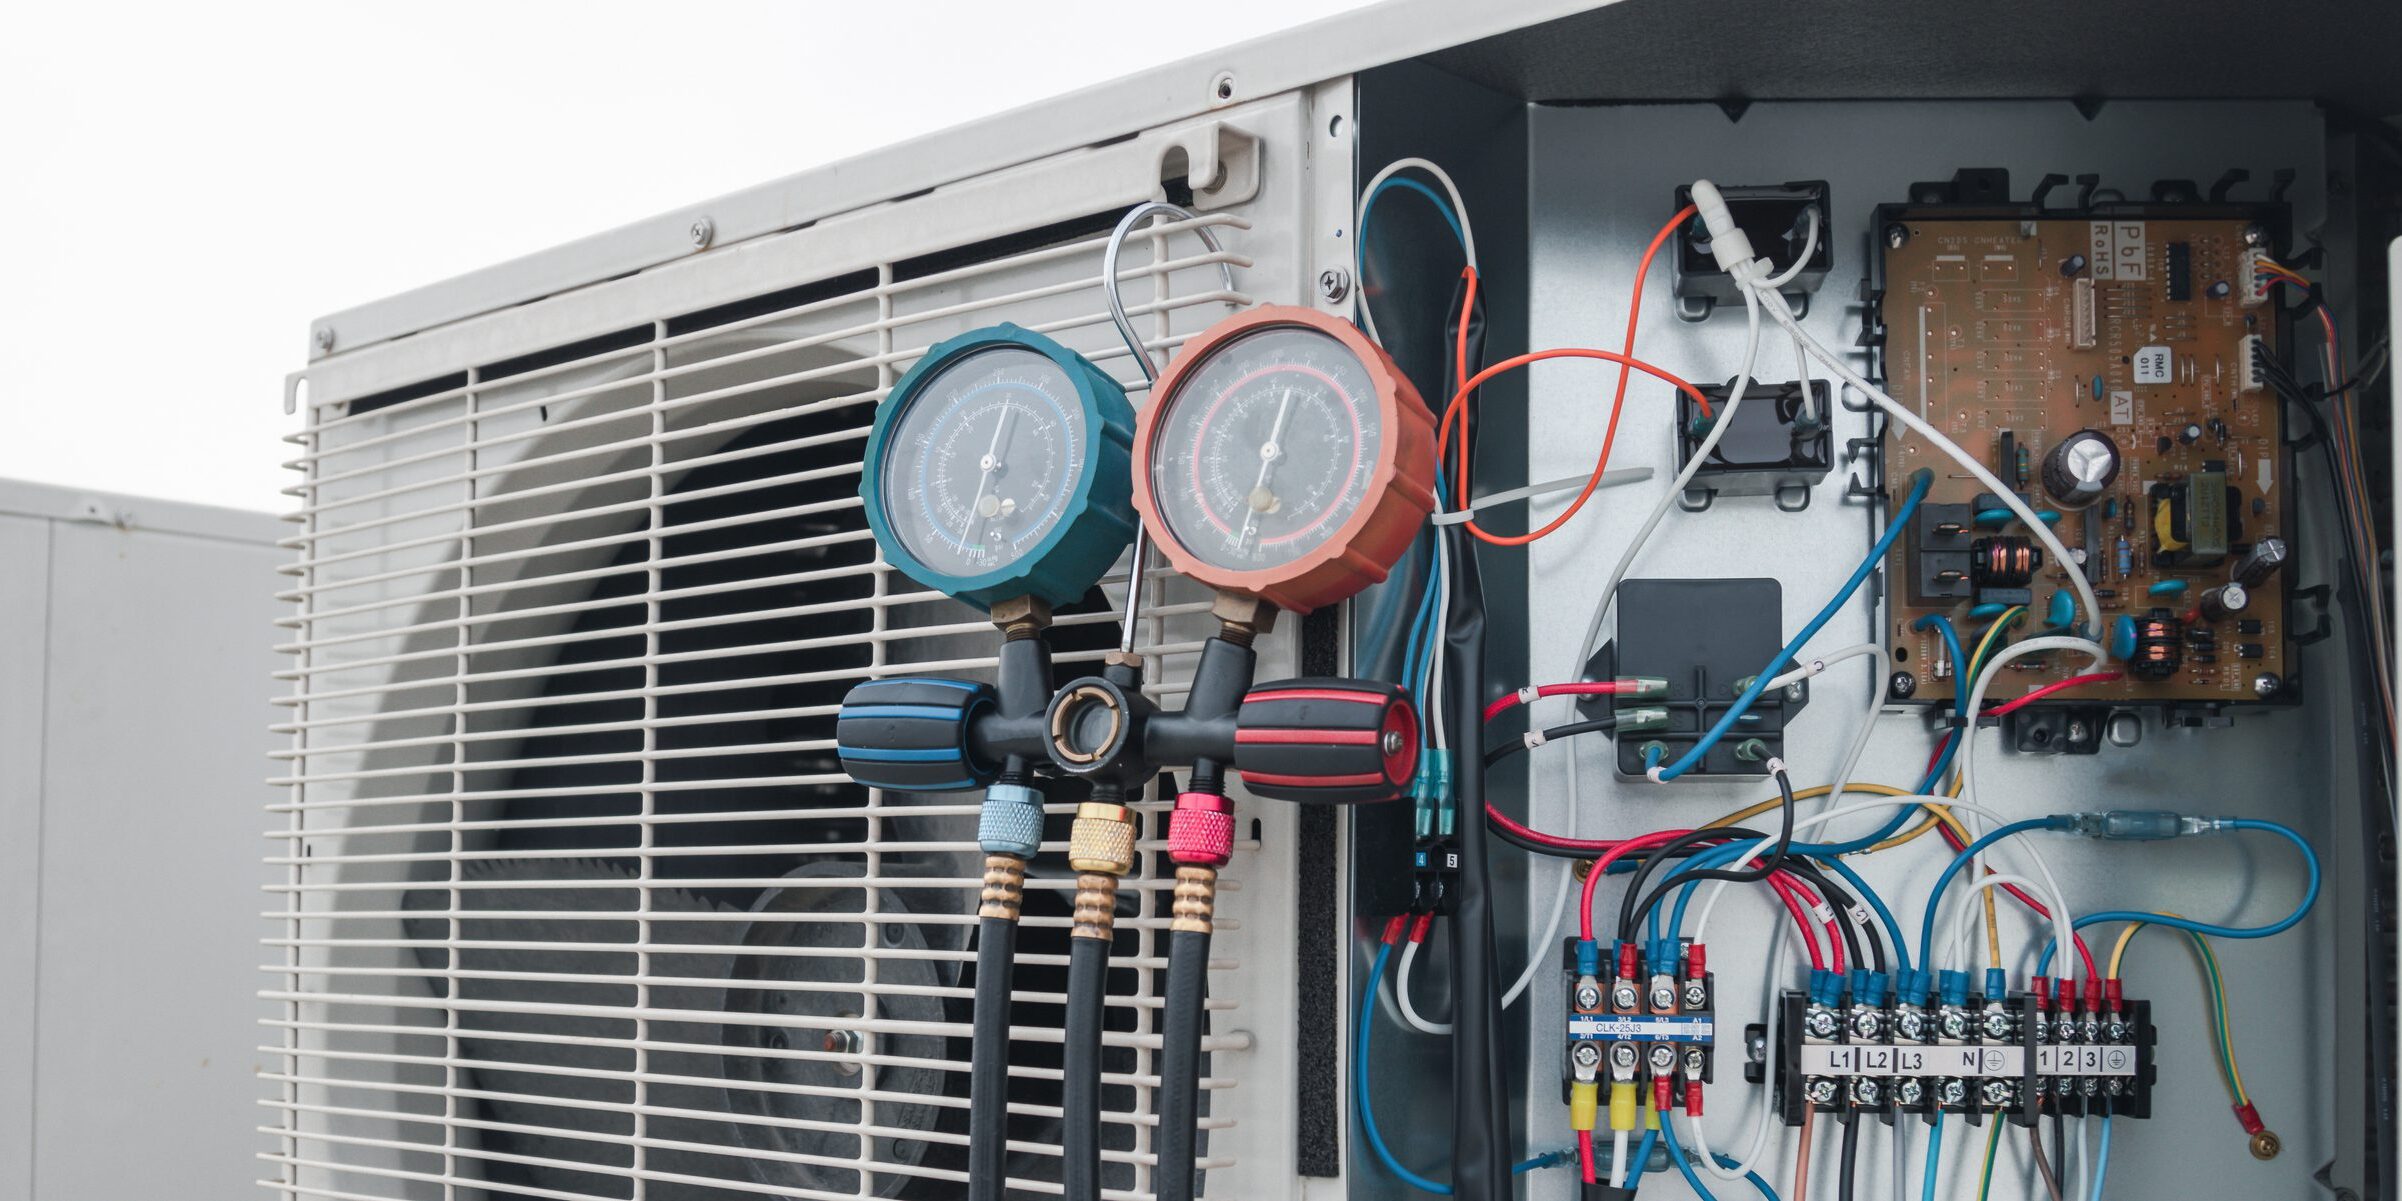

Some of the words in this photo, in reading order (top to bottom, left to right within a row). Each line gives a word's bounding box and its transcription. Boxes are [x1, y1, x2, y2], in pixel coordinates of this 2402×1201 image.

[2094, 224, 2109, 277] RoHS
[2120, 225, 2141, 278] PbF
[2140, 356, 2149, 376] 011
[2155, 353, 2164, 378] RMC
[2115, 395, 2128, 419] AT
[1595, 1023, 1642, 1033] CLK-25J3
[1830, 1051, 1849, 1068] L1
[1866, 1052, 1887, 1069] L2
[1902, 1053, 1922, 1070] L3
[1963, 1053, 1975, 1066] N
[2040, 1051, 2047, 1066] 1
[2063, 1051, 2074, 1066] 2
[2086, 1051, 2096, 1067] 3
